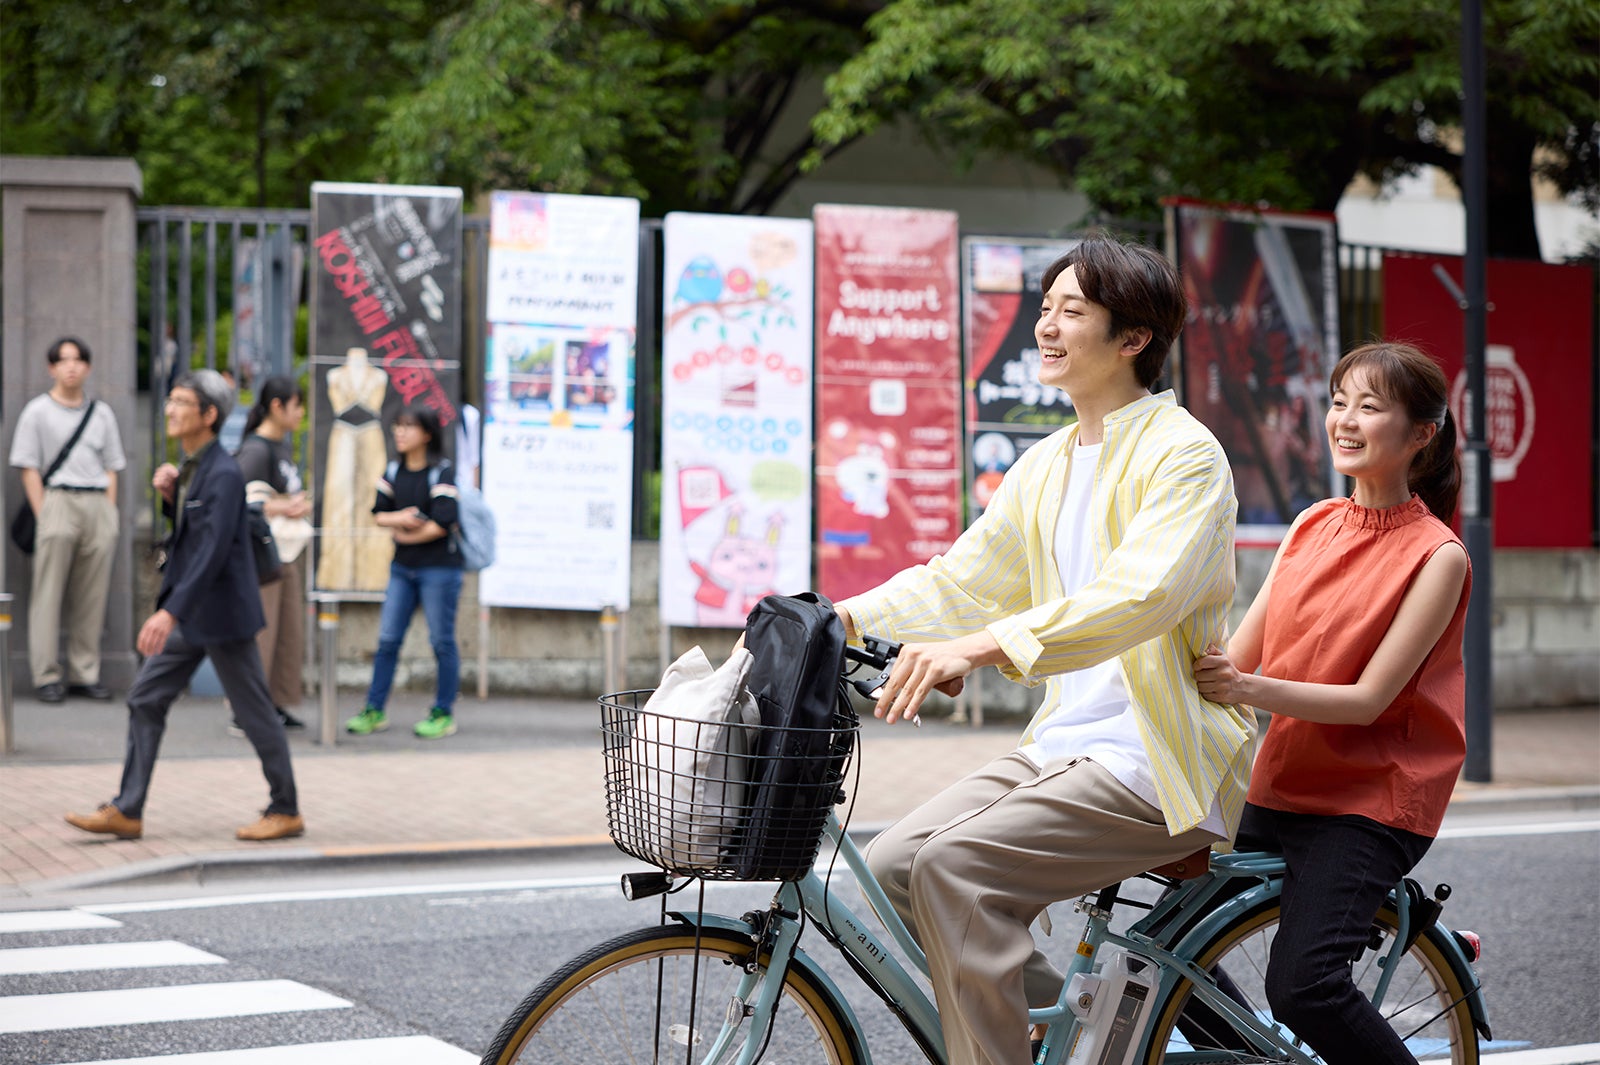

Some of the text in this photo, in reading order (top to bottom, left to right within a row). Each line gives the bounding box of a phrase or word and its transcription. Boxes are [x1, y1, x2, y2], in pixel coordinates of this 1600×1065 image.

[839, 280, 941, 316] Support
[827, 309, 948, 345] Anywhere
[857, 933, 887, 964] ami
